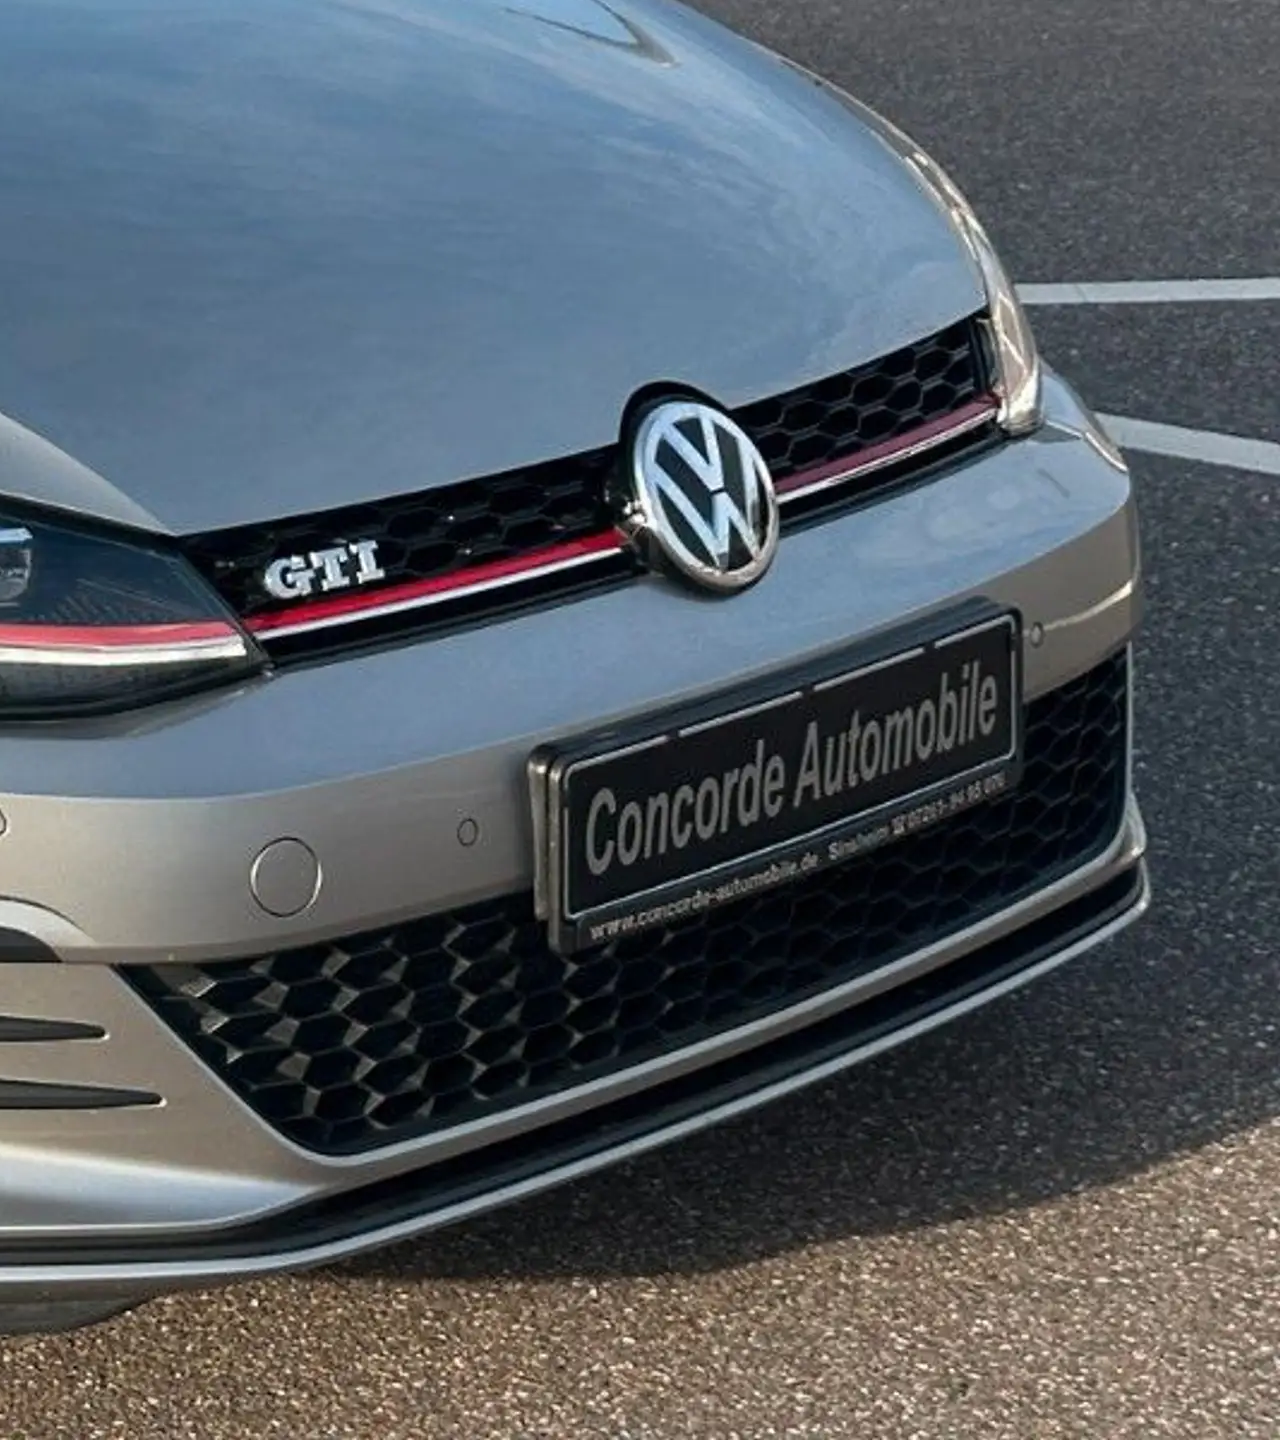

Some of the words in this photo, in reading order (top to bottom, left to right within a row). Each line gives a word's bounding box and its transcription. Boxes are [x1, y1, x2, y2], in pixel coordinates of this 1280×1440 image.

[263, 539, 385, 599] GTI
[585, 738, 785, 876] Concorde
[792, 660, 998, 809] Automobile
